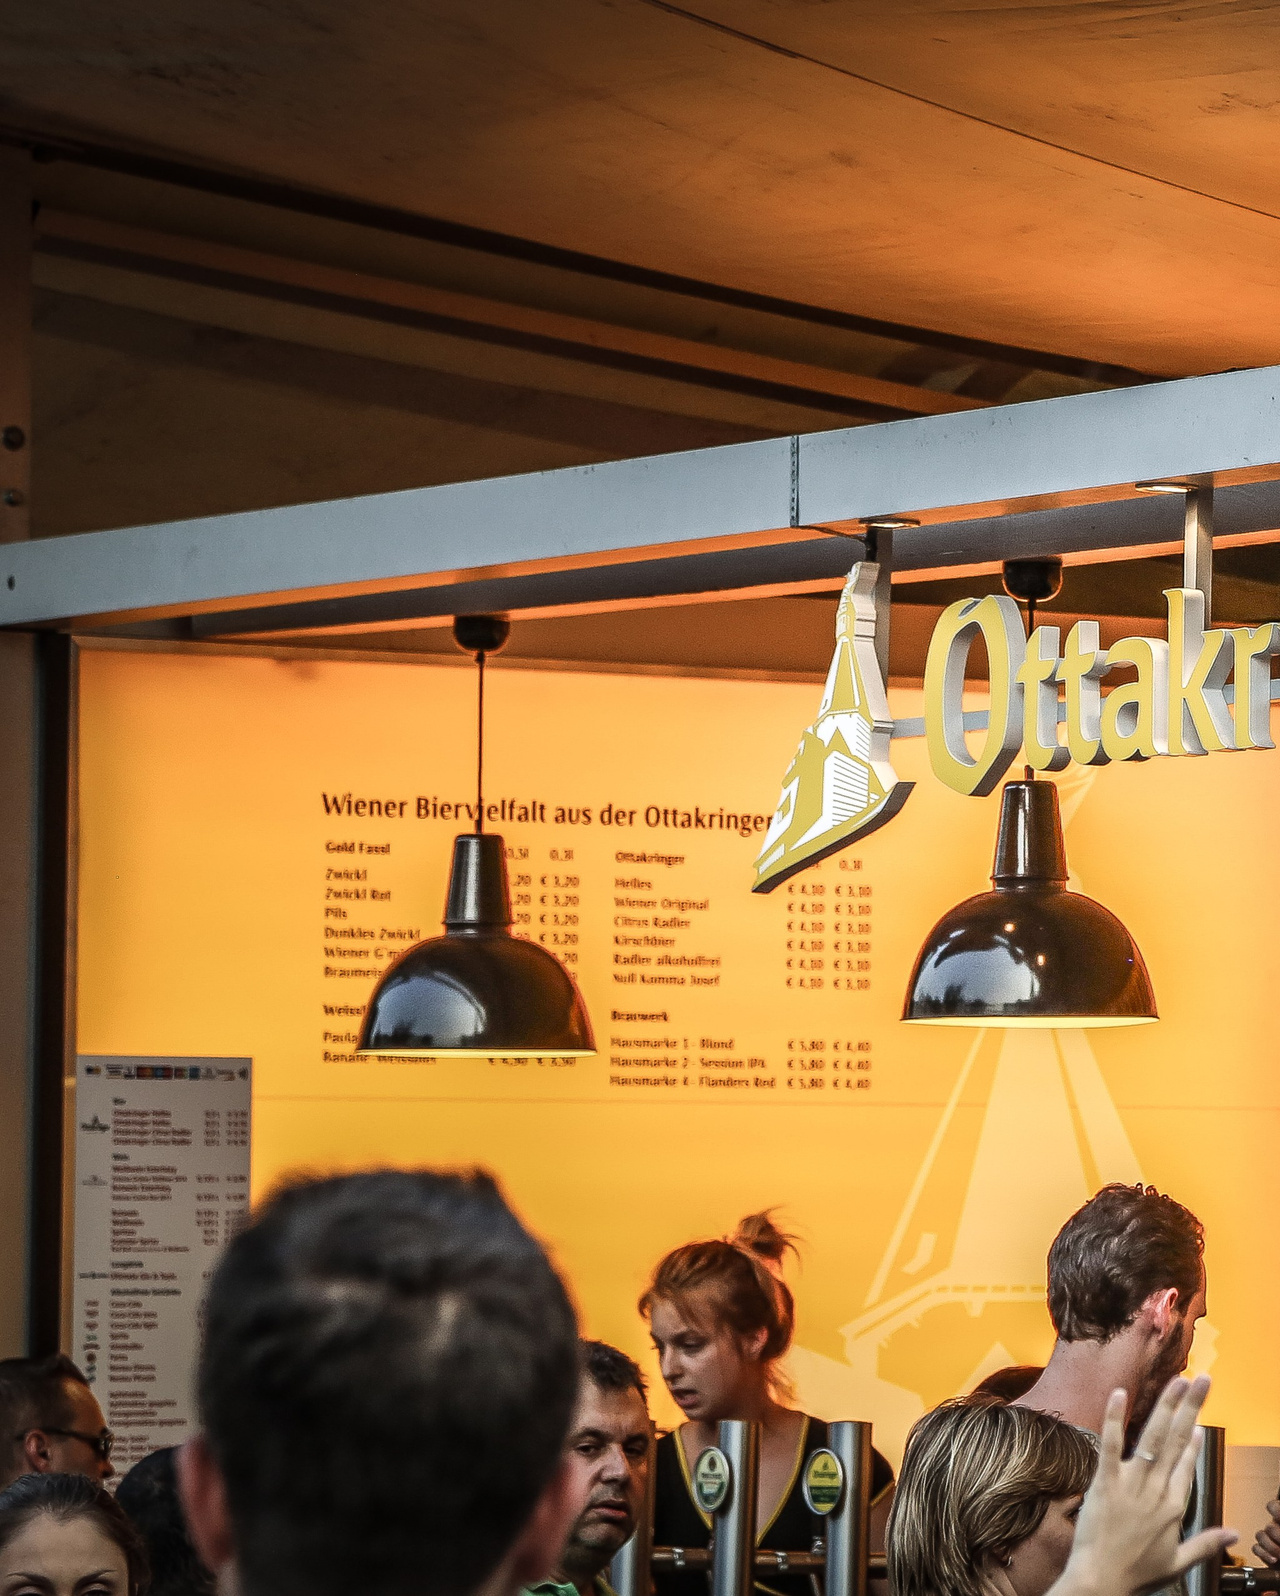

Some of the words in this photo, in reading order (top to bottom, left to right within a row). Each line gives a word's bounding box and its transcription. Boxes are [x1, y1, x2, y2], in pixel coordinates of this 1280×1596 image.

[322, 792, 407, 818] Wiener
[416, 797, 546, 823] Biervelfalt
[555, 807, 592, 826] aus
[600, 804, 637, 827] der
[645, 805, 773, 837] Ottakringer
[326, 842, 355, 854] Gold
